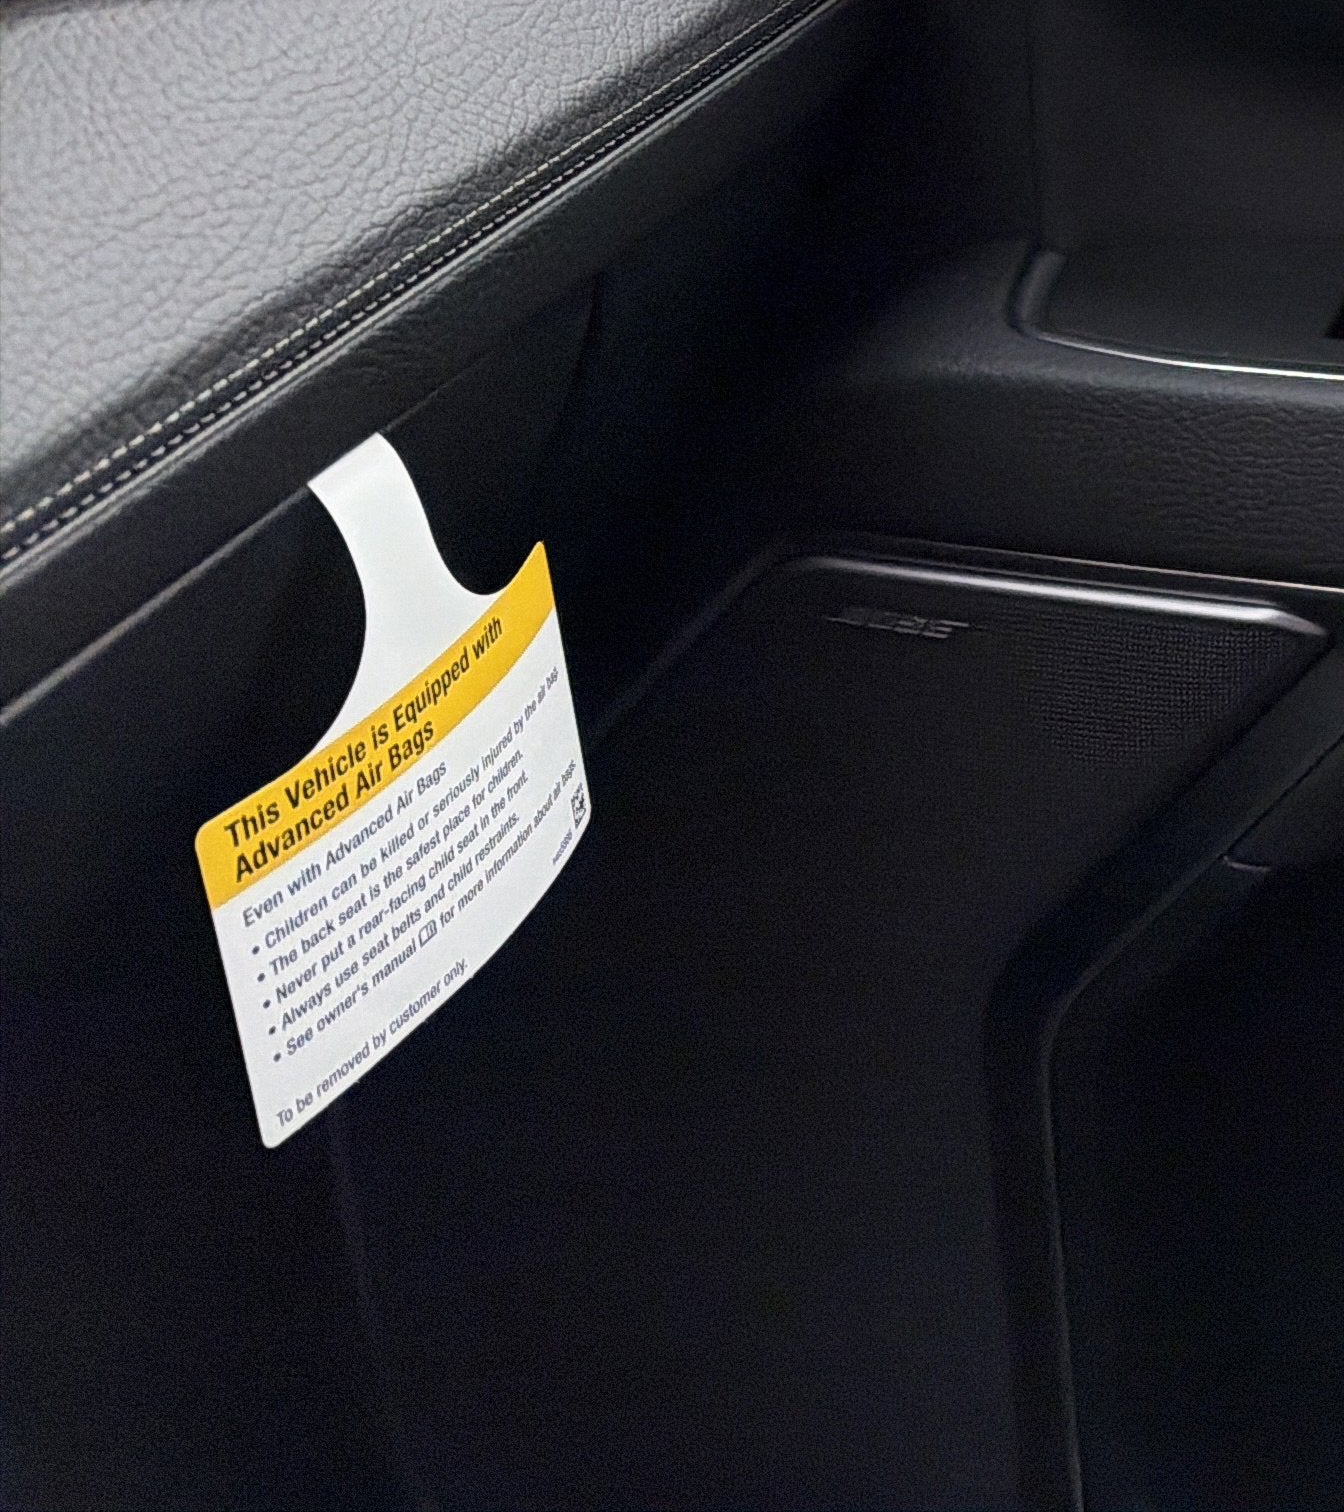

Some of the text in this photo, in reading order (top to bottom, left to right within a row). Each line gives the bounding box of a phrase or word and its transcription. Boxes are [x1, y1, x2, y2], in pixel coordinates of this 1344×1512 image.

[224, 617, 503, 848] This Vehicle is Equipped with
[235, 721, 434, 883] Advanced Air Bags
[265, 896, 328, 948] Children
[331, 873, 357, 901] can
[360, 857, 377, 879] be
[380, 823, 415, 862] killed
[417, 810, 430, 830] or
[433, 764, 480, 818] seriously
[481, 727, 513, 771] injured
[513, 715, 524, 736] by
[524, 698, 537, 722] the
[243, 761, 447, 927] Even with Advanced Air Bags
[269, 749, 524, 976] The back seat is the safest place for children.
[275, 962, 318, 1004] Never
[321, 940, 345, 972] put
[347, 934, 356, 949] a
[358, 874, 427, 940] rear-facing
[428, 848, 455, 880] child
[456, 823, 479, 854] seat
[480, 812, 490, 831] in
[490, 796, 506, 819] the
[282, 983, 332, 1030] Always
[334, 961, 359, 988] use
[362, 932, 390, 967] seat
[391, 907, 422, 941] belts
[424, 885, 446, 914] and
[448, 857, 473, 891] child
[474, 812, 520, 866] restraints.
[286, 1027, 314, 1056] See
[316, 982, 370, 1032] owner's
[371, 939, 417, 987] manual
[439, 904, 455, 928] for
[457, 878, 484, 912] more
[485, 823, 533, 884] information
[534, 793, 553, 829] about
[276, 958, 468, 1127] To be removed by customer only.
